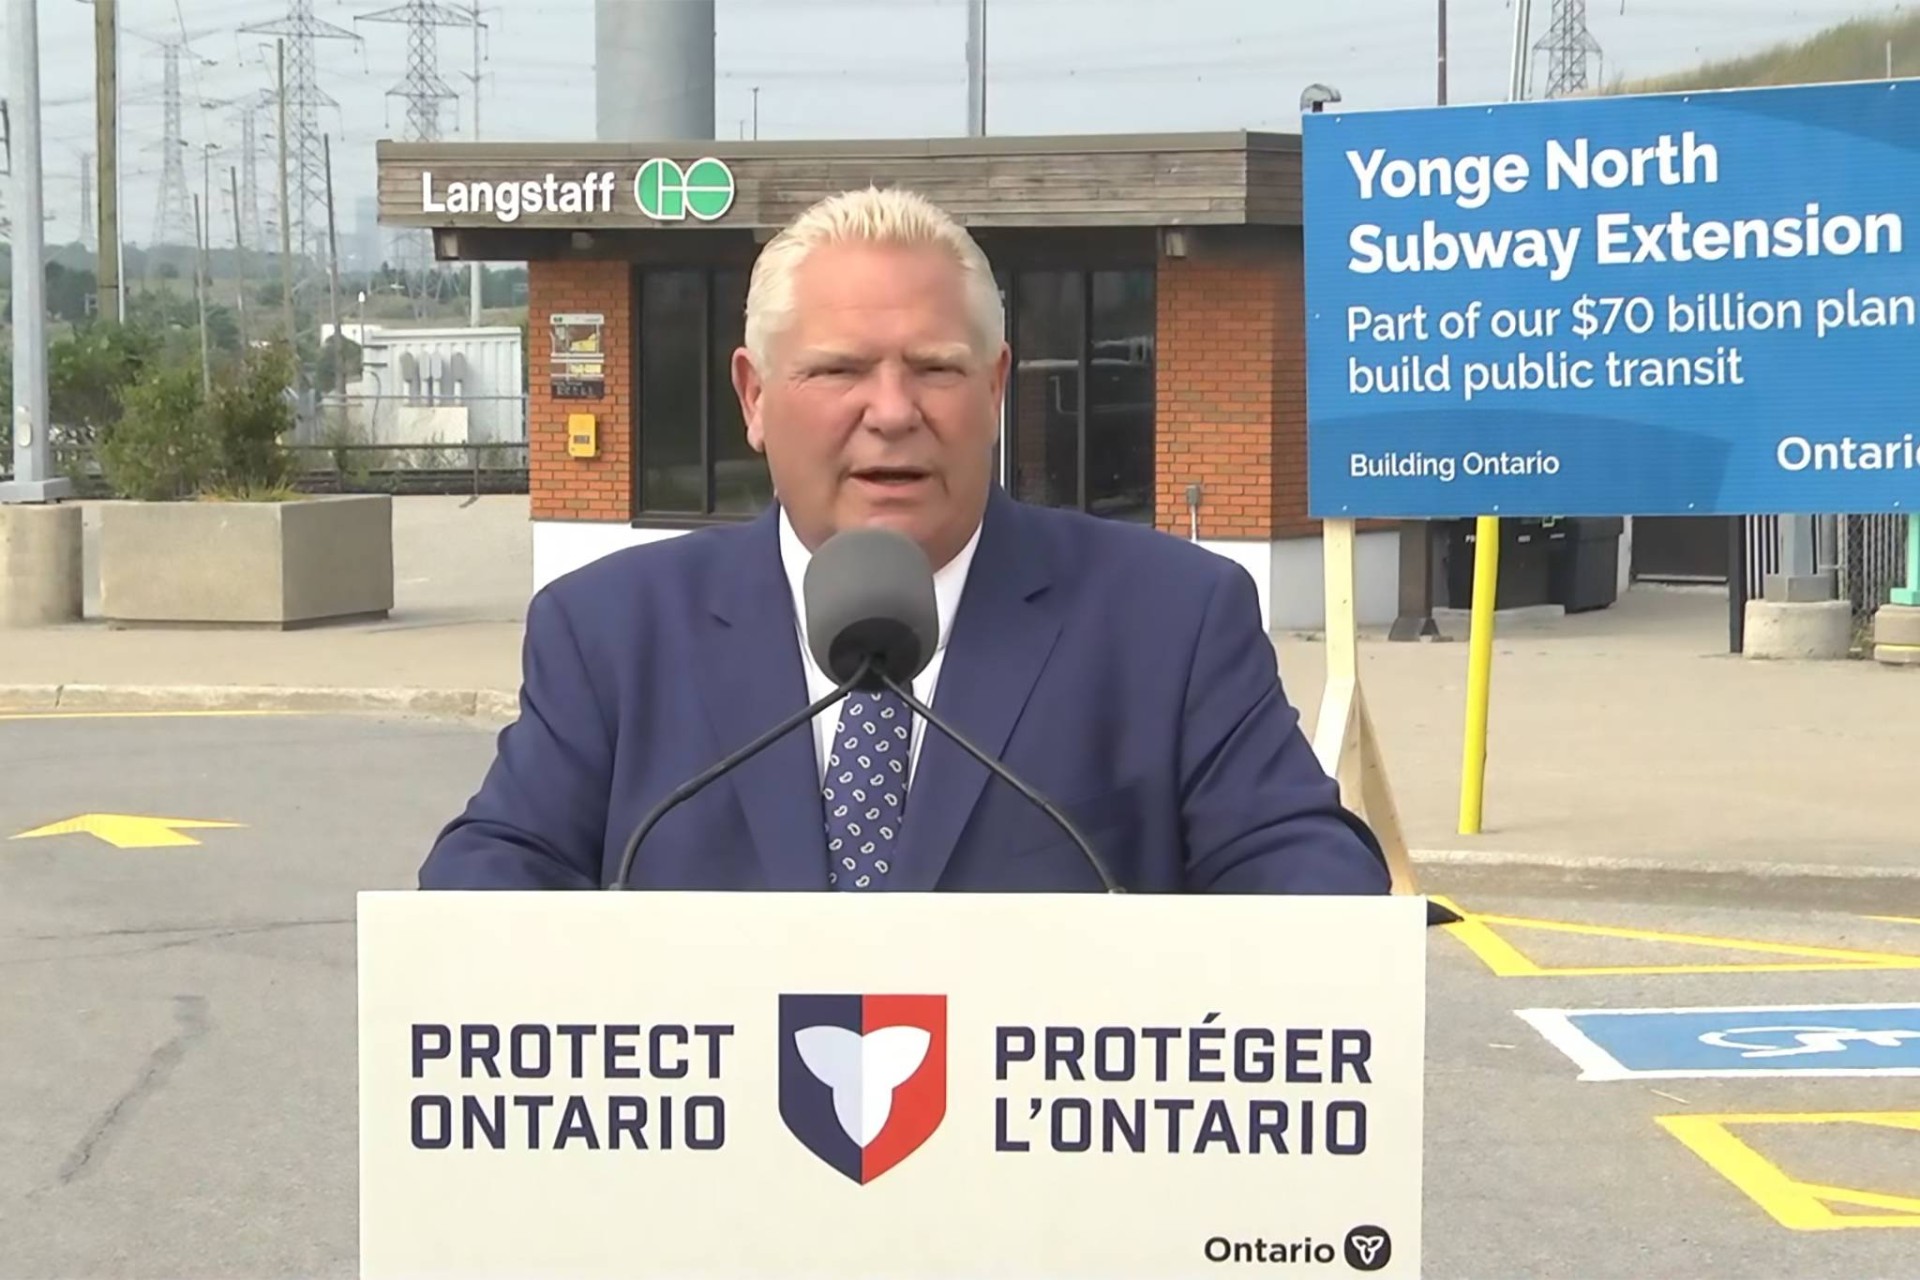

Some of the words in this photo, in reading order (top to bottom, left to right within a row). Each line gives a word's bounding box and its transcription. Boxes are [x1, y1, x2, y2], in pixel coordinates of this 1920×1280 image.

[422, 171, 615, 222] Langstaff
[1346, 148, 1530, 209] Yonge
[1546, 131, 1718, 190] North
[1348, 220, 1581, 281] Subway
[1597, 203, 1902, 264] Extension
[1348, 304, 1428, 342] Part
[1438, 301, 1482, 339] of
[1491, 307, 1561, 338] our
[1572, 293, 1654, 340] $70
[1668, 291, 1802, 332] billion
[1817, 287, 1915, 338] plan
[1349, 354, 1451, 394] build
[1464, 351, 1593, 401] public
[1605, 346, 1744, 387] transit
[1350, 452, 1455, 481] Building
[1463, 451, 1560, 475] Ontario
[1777, 433, 1920, 471] Ontari
[411, 1023, 735, 1079] PROTECT
[995, 1012, 1373, 1084] PROTÉGER
[410, 1094, 726, 1151] ONTARIO
[1204, 1235, 1336, 1264] Ontario
